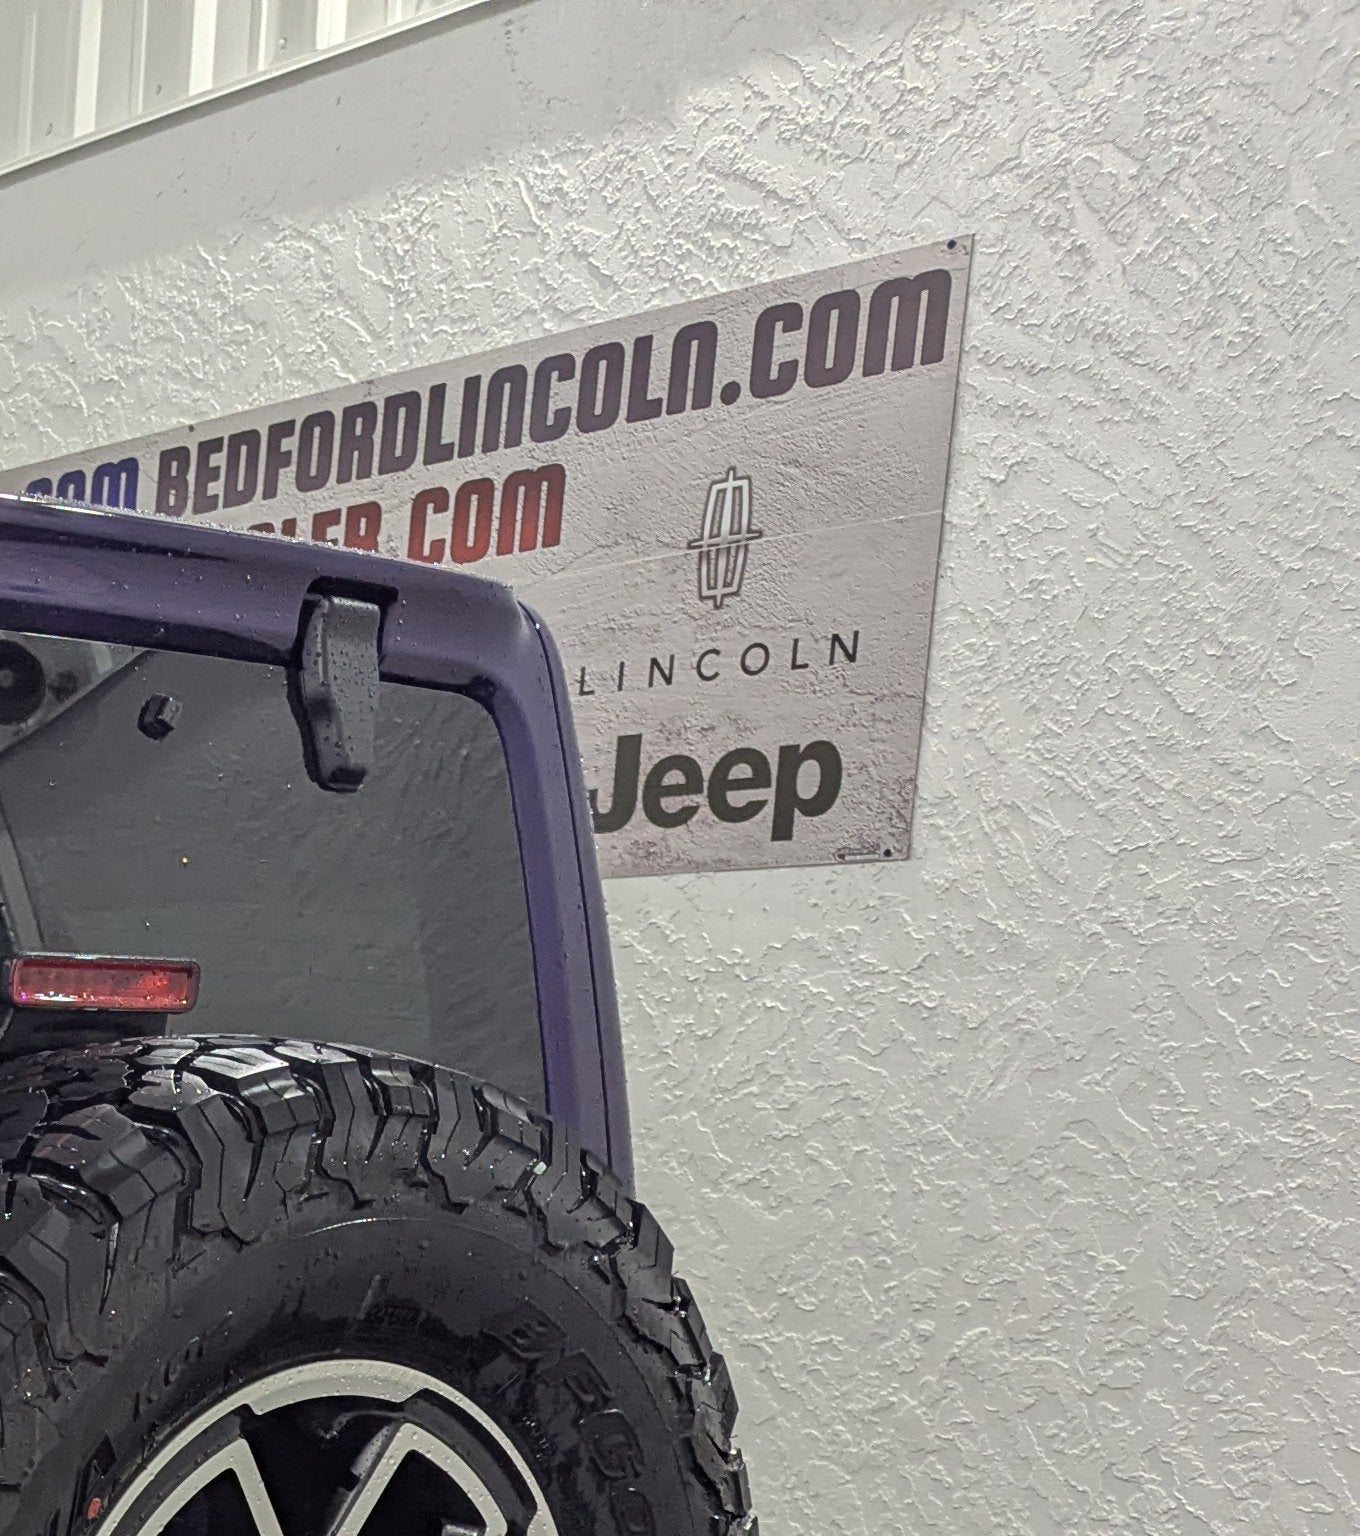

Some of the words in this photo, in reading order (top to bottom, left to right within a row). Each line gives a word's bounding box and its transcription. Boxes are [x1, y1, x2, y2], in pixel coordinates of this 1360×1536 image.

[156, 269, 952, 517] BEDFORDLINCOLN.COM
[579, 630, 860, 696] LINCOLN
[587, 733, 843, 842] Jeep
